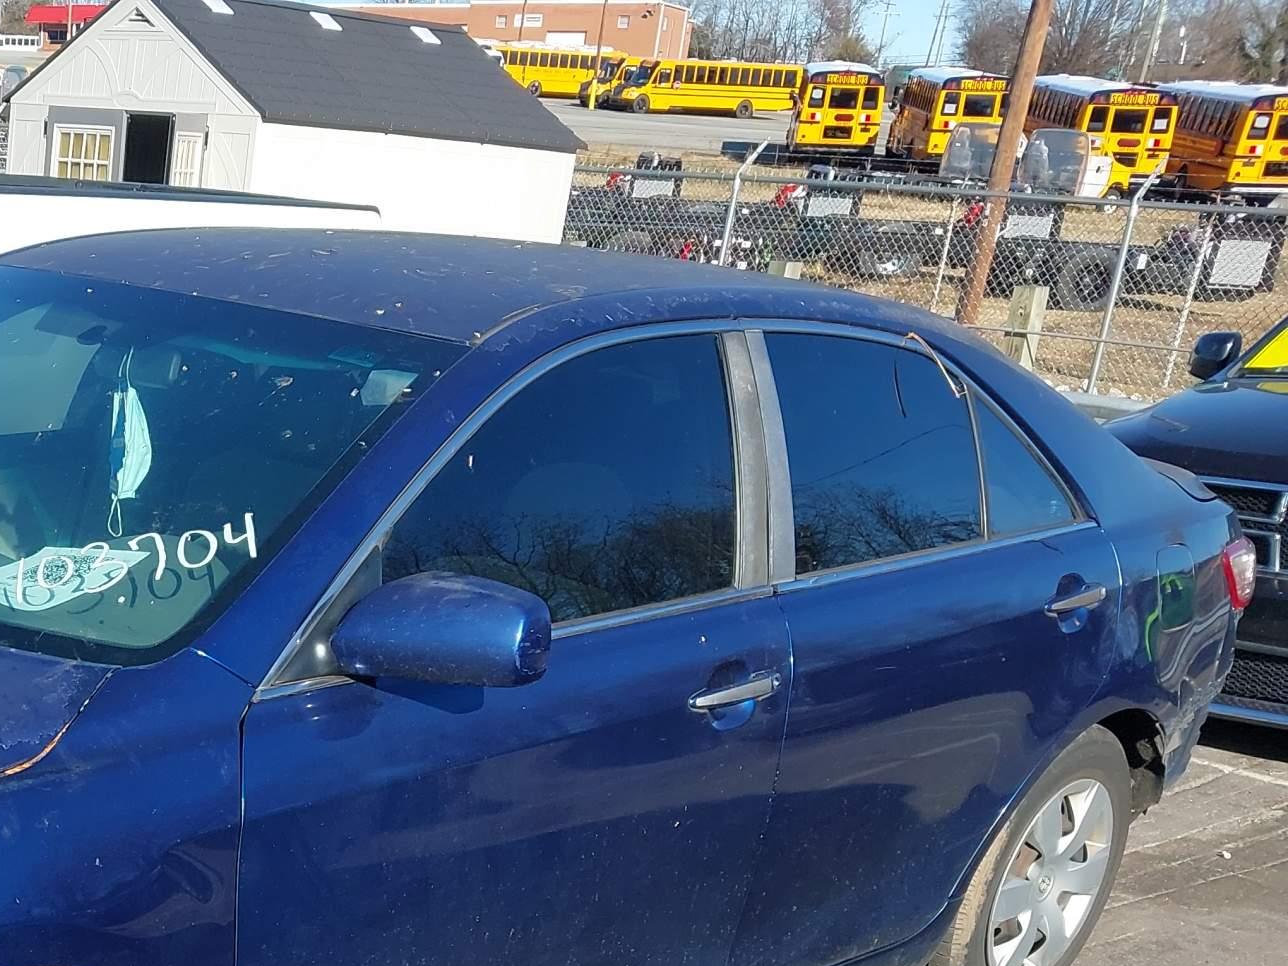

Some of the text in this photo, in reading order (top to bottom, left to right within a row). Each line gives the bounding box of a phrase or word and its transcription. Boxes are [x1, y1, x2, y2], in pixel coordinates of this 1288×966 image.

[1112, 94, 1159, 105] SCHOOL BUS
[16, 512, 257, 605] 103704
